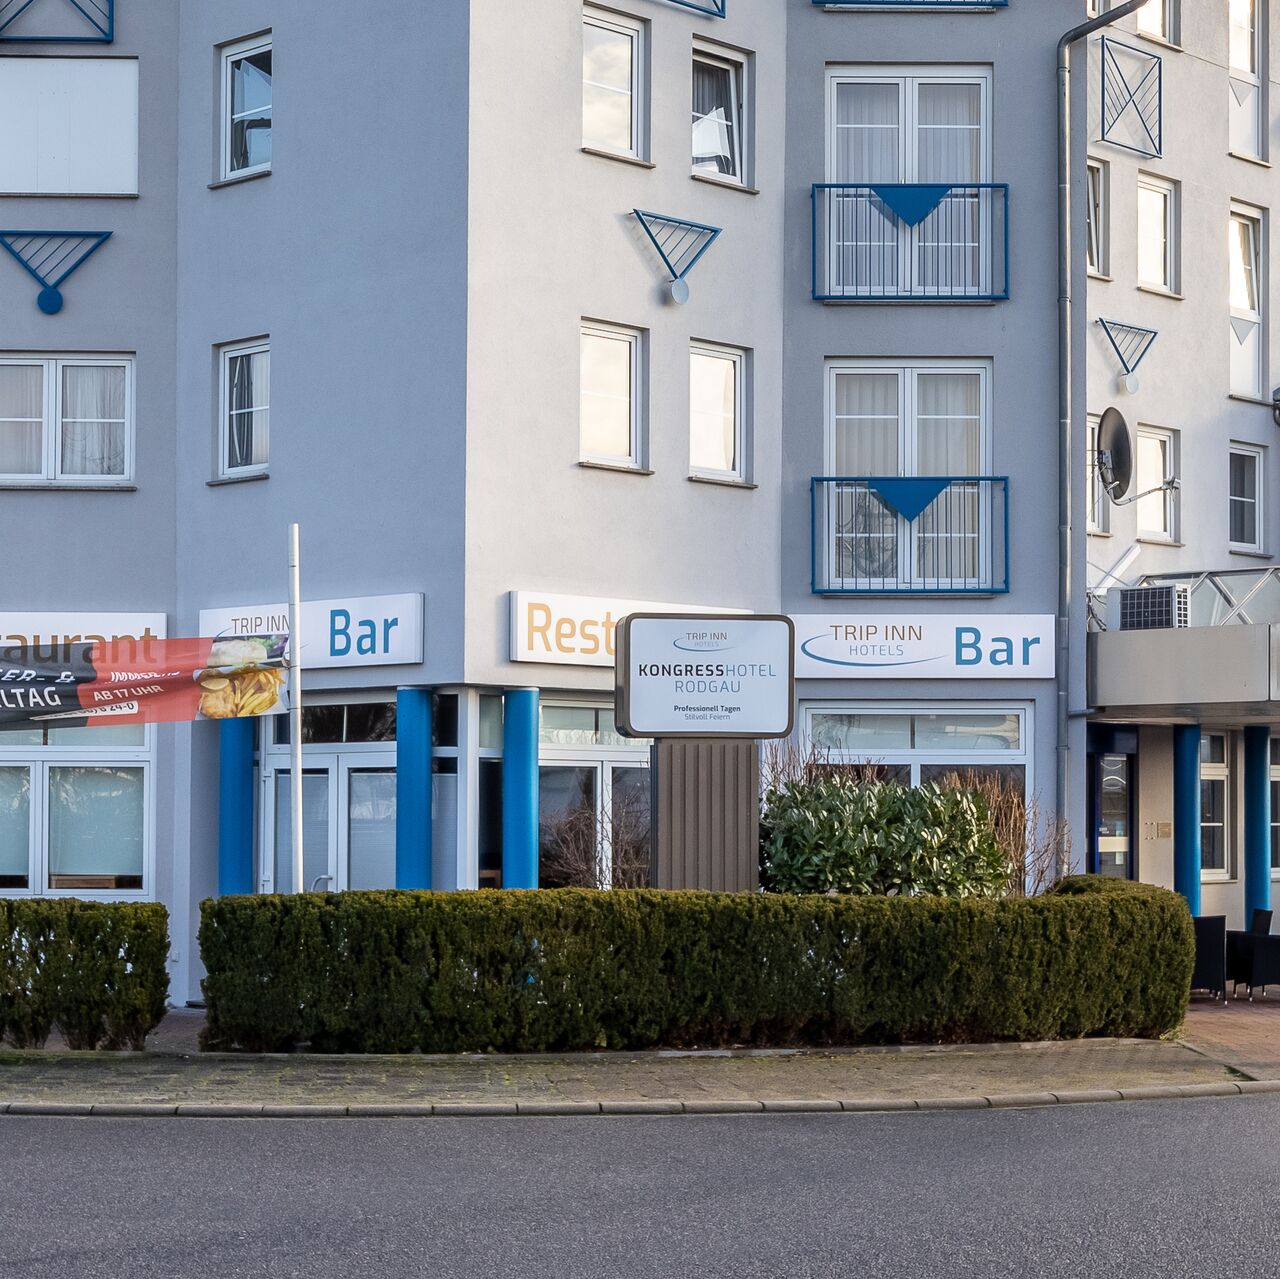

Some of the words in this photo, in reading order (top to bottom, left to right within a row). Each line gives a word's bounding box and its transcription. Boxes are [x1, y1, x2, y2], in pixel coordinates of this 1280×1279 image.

[231, 616, 263, 635] TRIP
[266, 614, 289, 632] INN
[329, 608, 399, 657] Bar
[686, 632, 708, 641] TRIP
[710, 632, 728, 641] INN
[830, 625, 878, 641] TRIP
[885, 625, 922, 641] INN
[849, 644, 904, 656] HOTELS
[955, 626, 1041, 666] Bar
[638, 663, 777, 677] KONGRESSHOTEL
[93, 691, 114, 702] AB
[114, 690, 129, 699] 17
[131, 685, 165, 697] UHR
[675, 680, 742, 693] RODGAU
[673, 704, 719, 713] Professionell
[720, 705, 741, 714] Tagen
[684, 713, 708, 721] Stilvoll
[709, 713, 731, 721] Feiern
